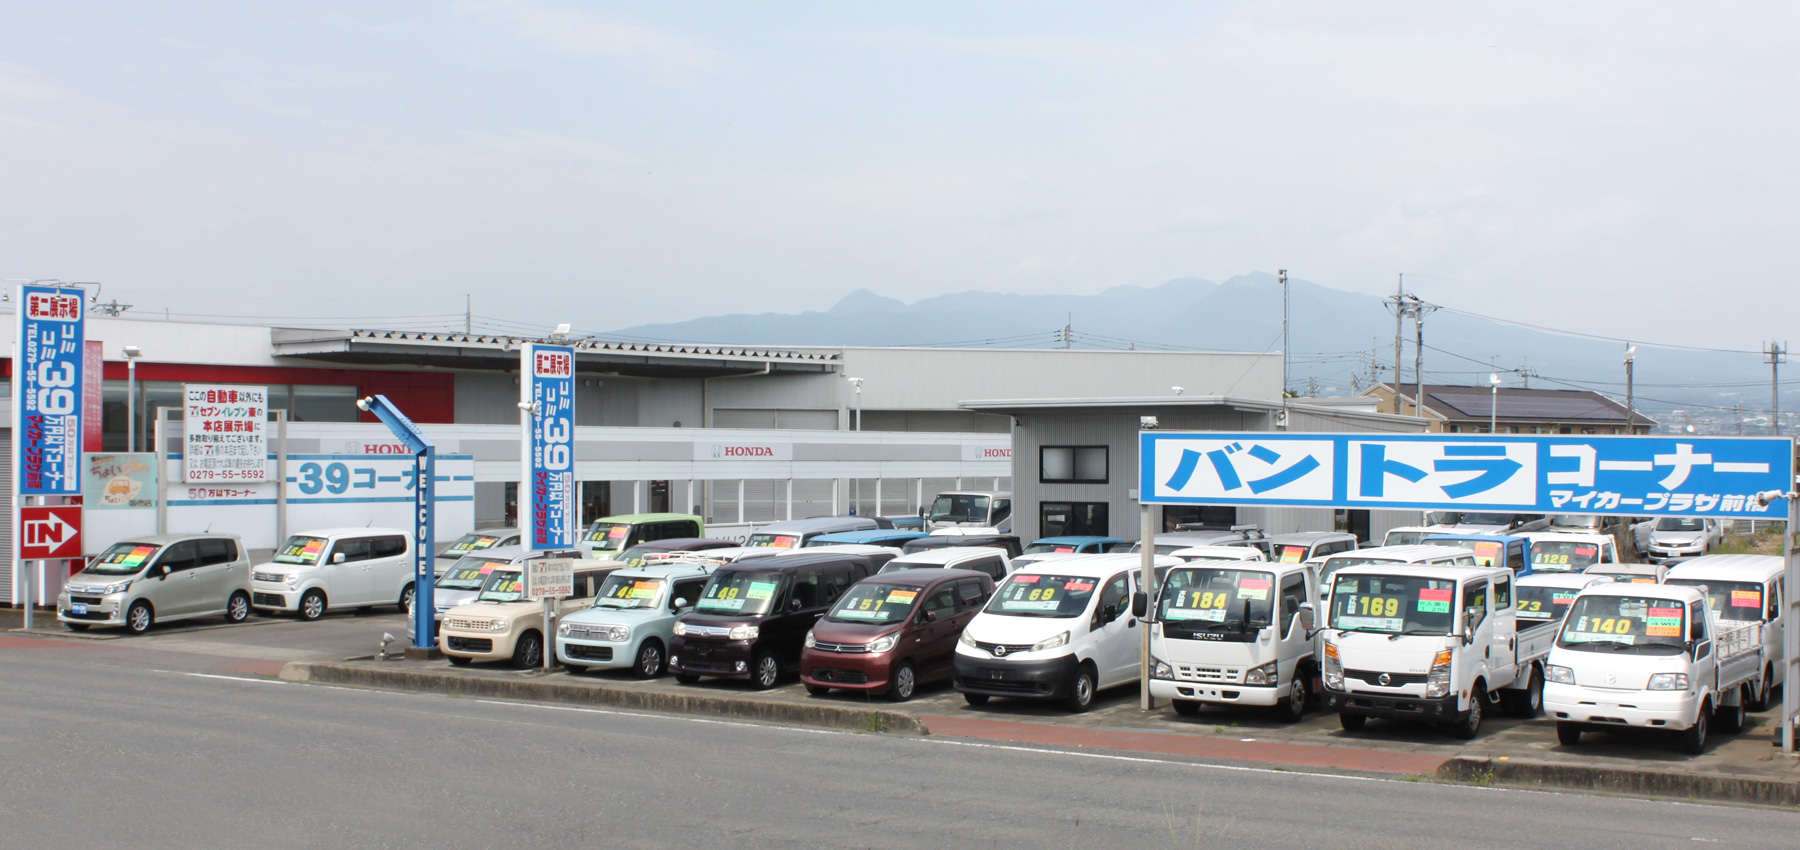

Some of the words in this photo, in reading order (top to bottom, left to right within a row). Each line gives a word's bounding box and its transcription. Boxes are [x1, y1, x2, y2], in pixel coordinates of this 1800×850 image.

[30, 296, 78, 319] 第二展示場
[536, 353, 570, 375] 第二展示場
[203, 420, 261, 433] 本店展示場に
[724, 446, 774, 457] HONDA
[190, 470, 264, 479] 0279-55-5592
[1165, 442, 1321, 495] バン
[1359, 443, 1523, 500] トラ
[1547, 443, 1770, 491] コーナー
[27, 523, 63, 545] IN
[1543, 553, 1569, 564] 128
[717, 586, 739, 600] 49
[1191, 591, 1227, 609] 184
[859, 598, 884, 611] 51
[1360, 596, 1399, 617] 169
[1516, 600, 1542, 611] 73
[1591, 617, 1631, 634] 140
[1193, 632, 1224, 640] ISUZU
